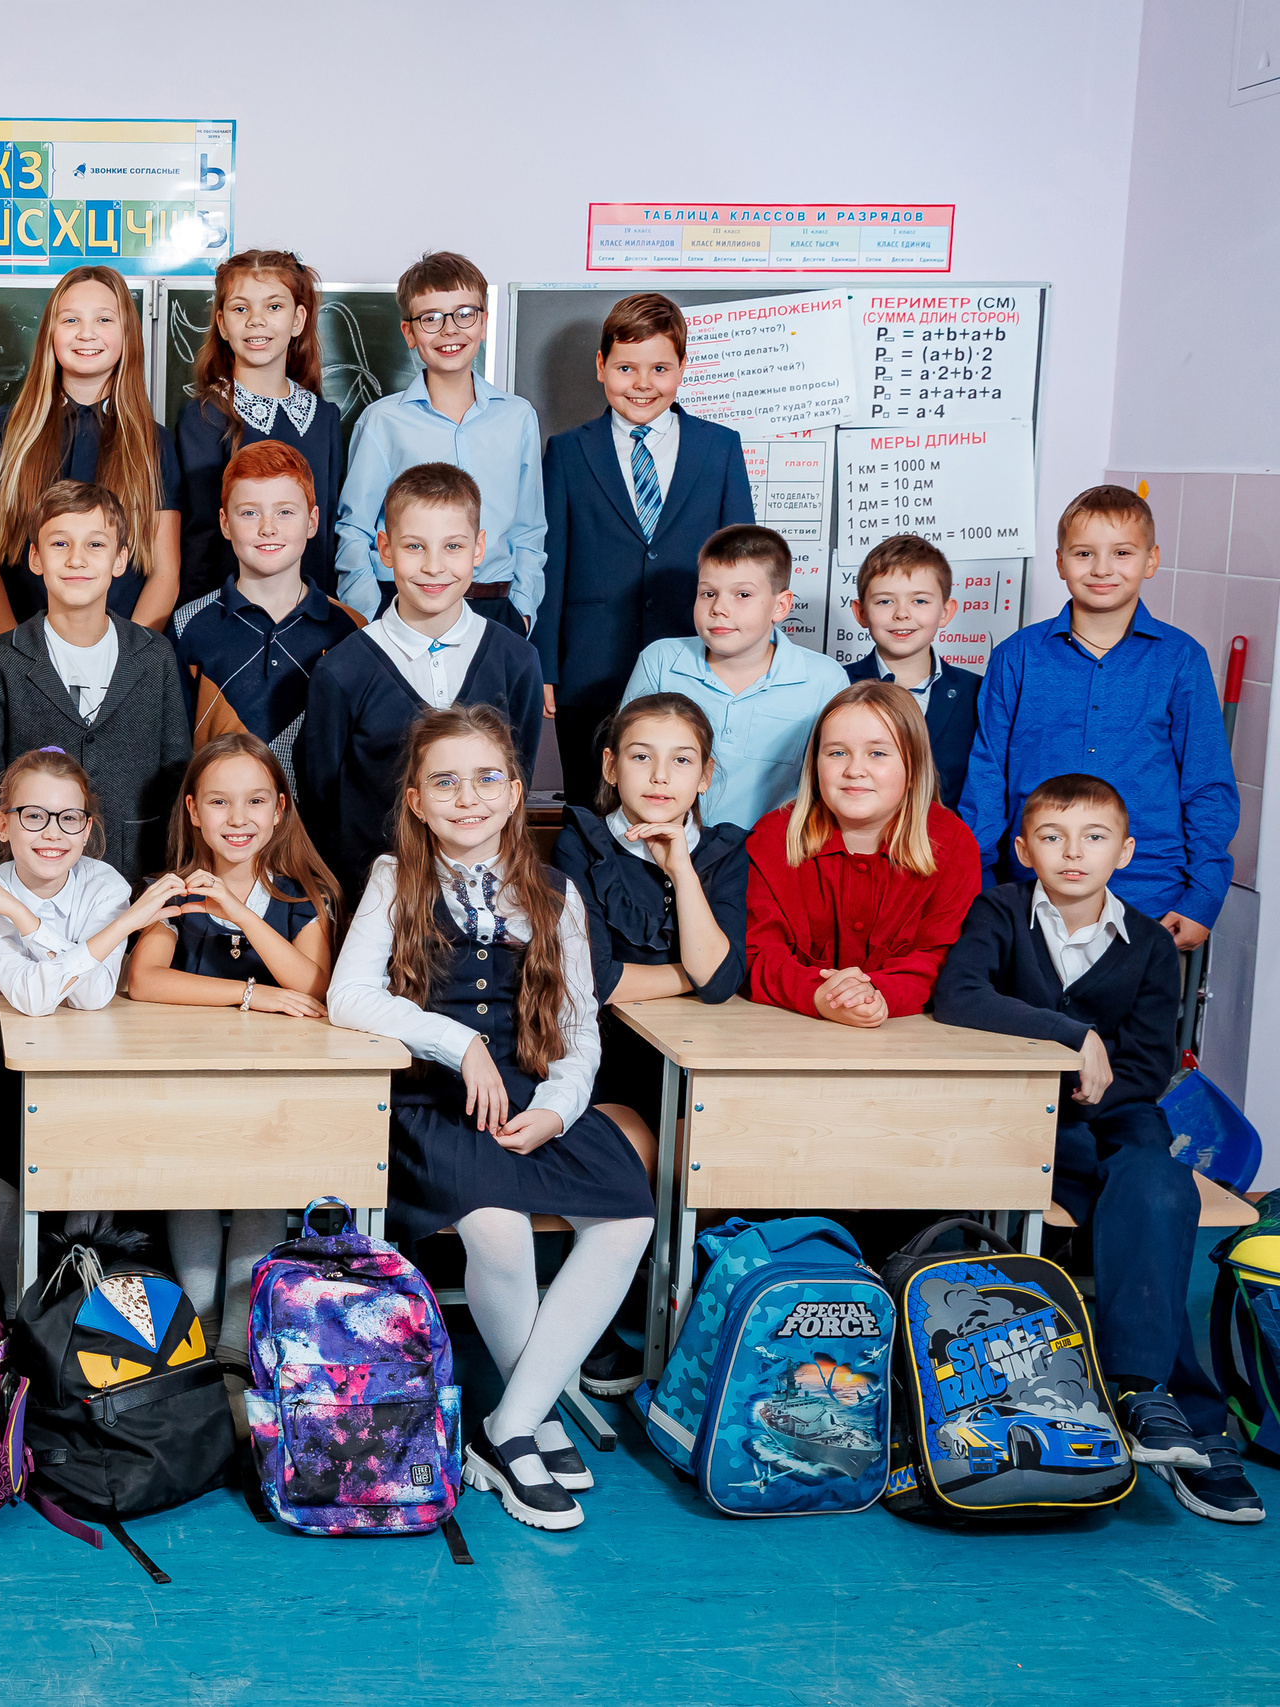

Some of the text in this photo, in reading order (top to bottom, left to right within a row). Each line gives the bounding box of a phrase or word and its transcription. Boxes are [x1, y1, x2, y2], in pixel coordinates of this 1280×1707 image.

[644, 210, 923, 222] ТАБЛИЦА КЛАССОВ И РАЗРЯДОВ
[871, 297, 1016, 311] ПЕРИМЕТР (СМ)
[684, 299, 842, 328] ЗБОР ПРЕДЛОЖЕНИЯ
[863, 312, 1020, 325] (СУММА ДЛИН СТОРОН)
[687, 332, 728, 342] лежащее
[683, 371, 734, 384] ределение
[737, 365, 774, 378] (какой?
[790, 378, 839, 392] вопросы)
[698, 409, 752, 420] оятельство
[783, 400, 812, 412] куда?
[815, 395, 850, 407] когда?
[770, 412, 811, 423] откуда?
[871, 432, 986, 450] МЕРЫ ДЛИНЫ
[846, 463, 853, 475] 1
[858, 464, 876, 474] км
[894, 459, 925, 472] 1000
[930, 461, 940, 470] м
[846, 481, 853, 493] 1
[859, 482, 868, 492] м
[894, 478, 908, 490] 10
[913, 479, 934, 491] дм
[847, 499, 853, 511] 1
[858, 500, 878, 512] дм
[894, 496, 909, 508] 10
[914, 497, 932, 507] см
[848, 517, 854, 529] 1
[860, 519, 877, 529] см
[894, 514, 909, 526] 10
[915, 516, 936, 526] мм
[848, 534, 854, 546] 1
[860, 536, 870, 546] м
[960, 527, 992, 540] 1000
[998, 528, 1018, 538] мм
[965, 577, 991, 589] раз
[963, 601, 989, 612] раз
[837, 629, 853, 641] Во
[939, 631, 986, 643] больше
[836, 651, 852, 662] Во
[942, 655, 984, 664] еньше
[793, 1304, 872, 1318] SPECIAL
[778, 1316, 880, 1336] FORCE
[947, 1307, 1072, 1372] STREET CLUB
[938, 1345, 1053, 1413] RACING
